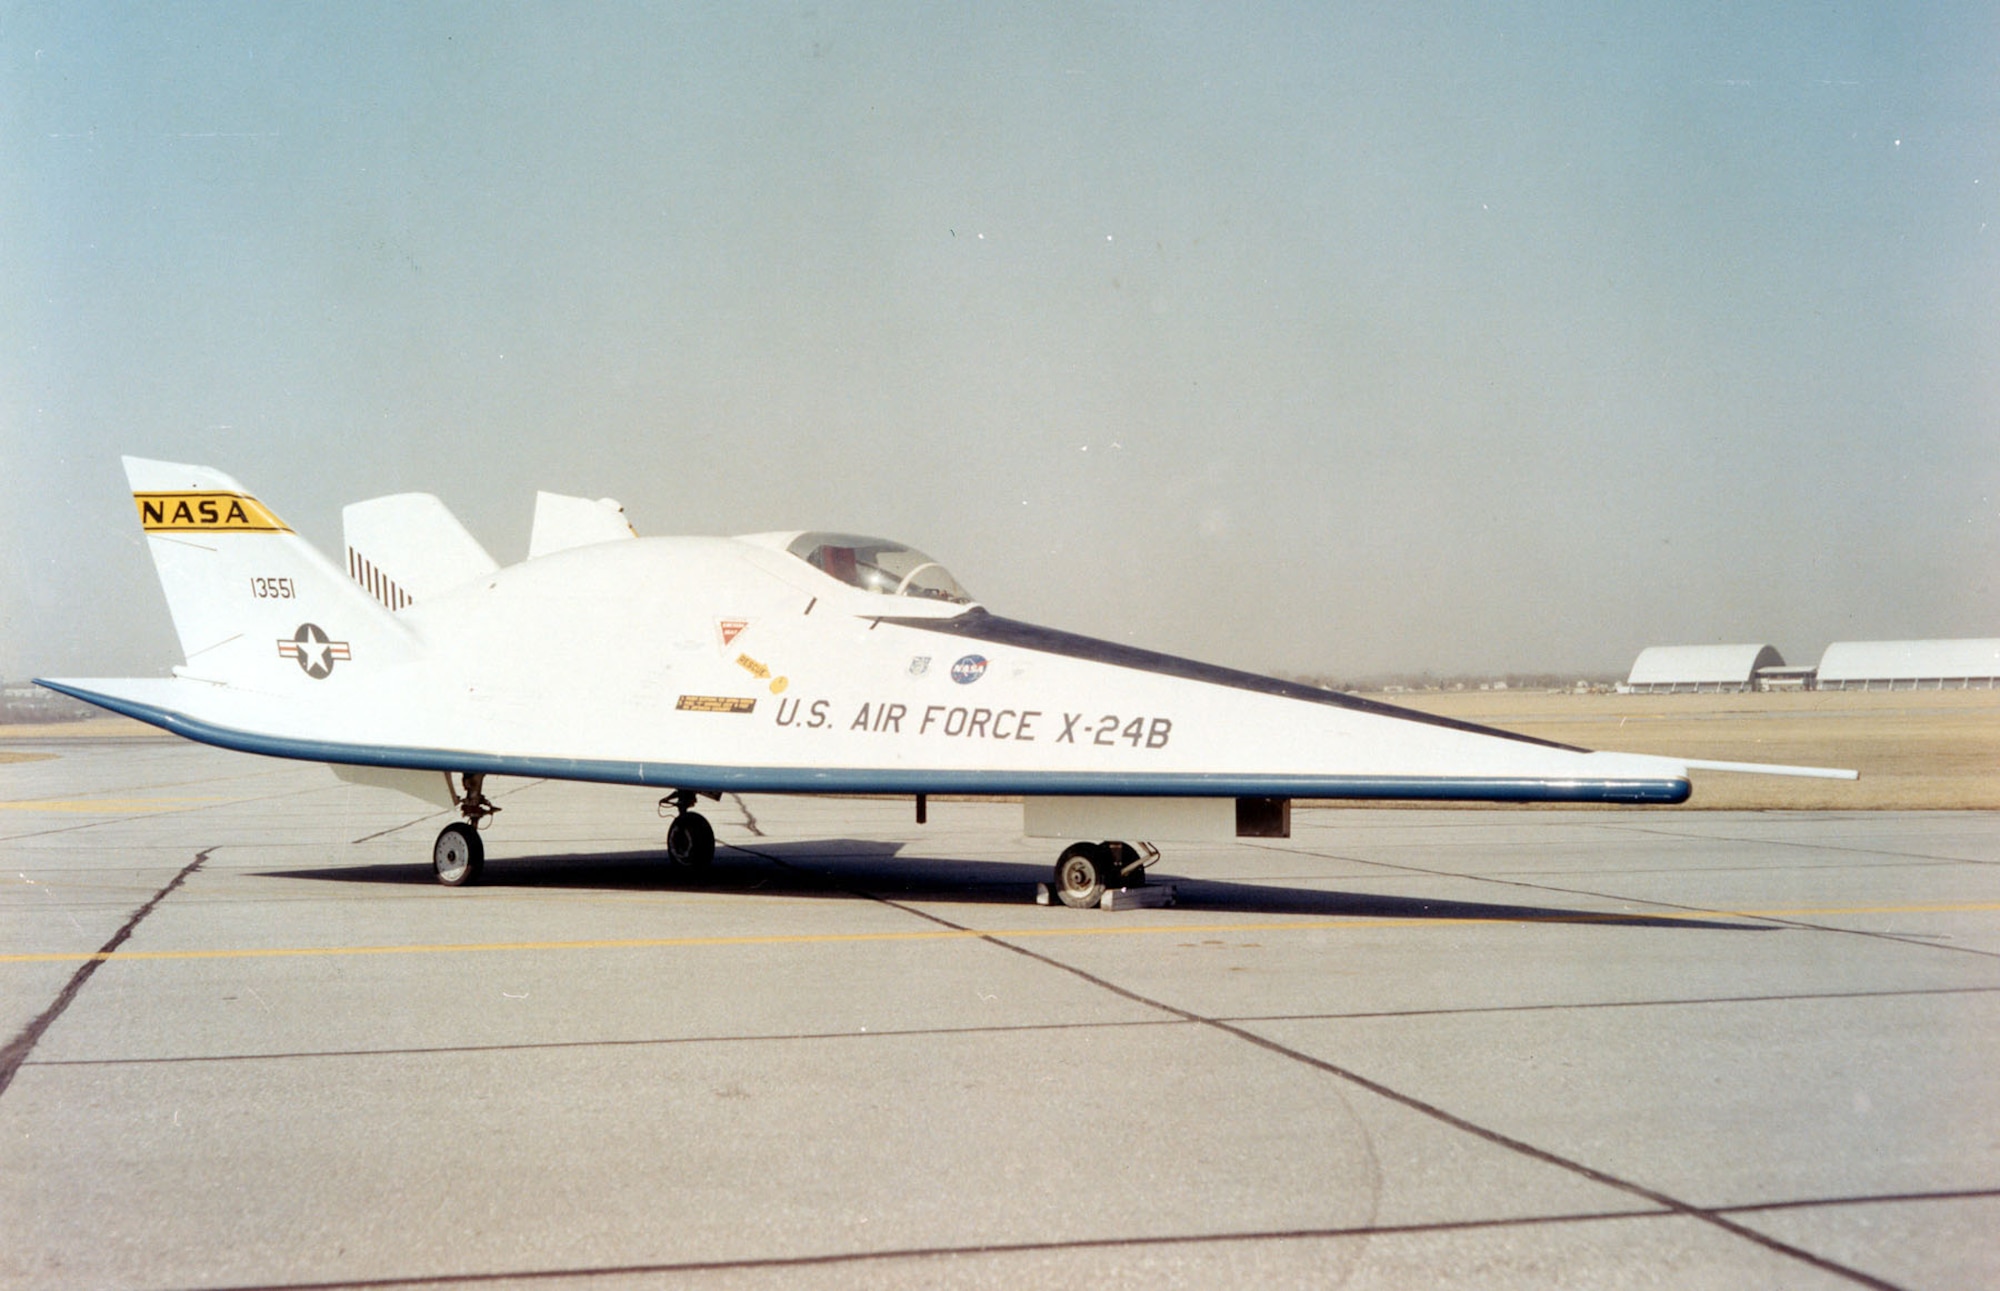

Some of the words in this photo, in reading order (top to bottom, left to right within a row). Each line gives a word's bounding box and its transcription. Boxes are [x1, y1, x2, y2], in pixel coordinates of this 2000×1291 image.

[142, 500, 249, 524] NASA
[250, 577, 296, 599] 13551
[952, 663, 984, 676] NASA
[775, 698, 834, 730] U.S.
[850, 701, 908, 734] AIR
[919, 705, 1043, 742] FORCE
[1055, 712, 1173, 750] X-24B
